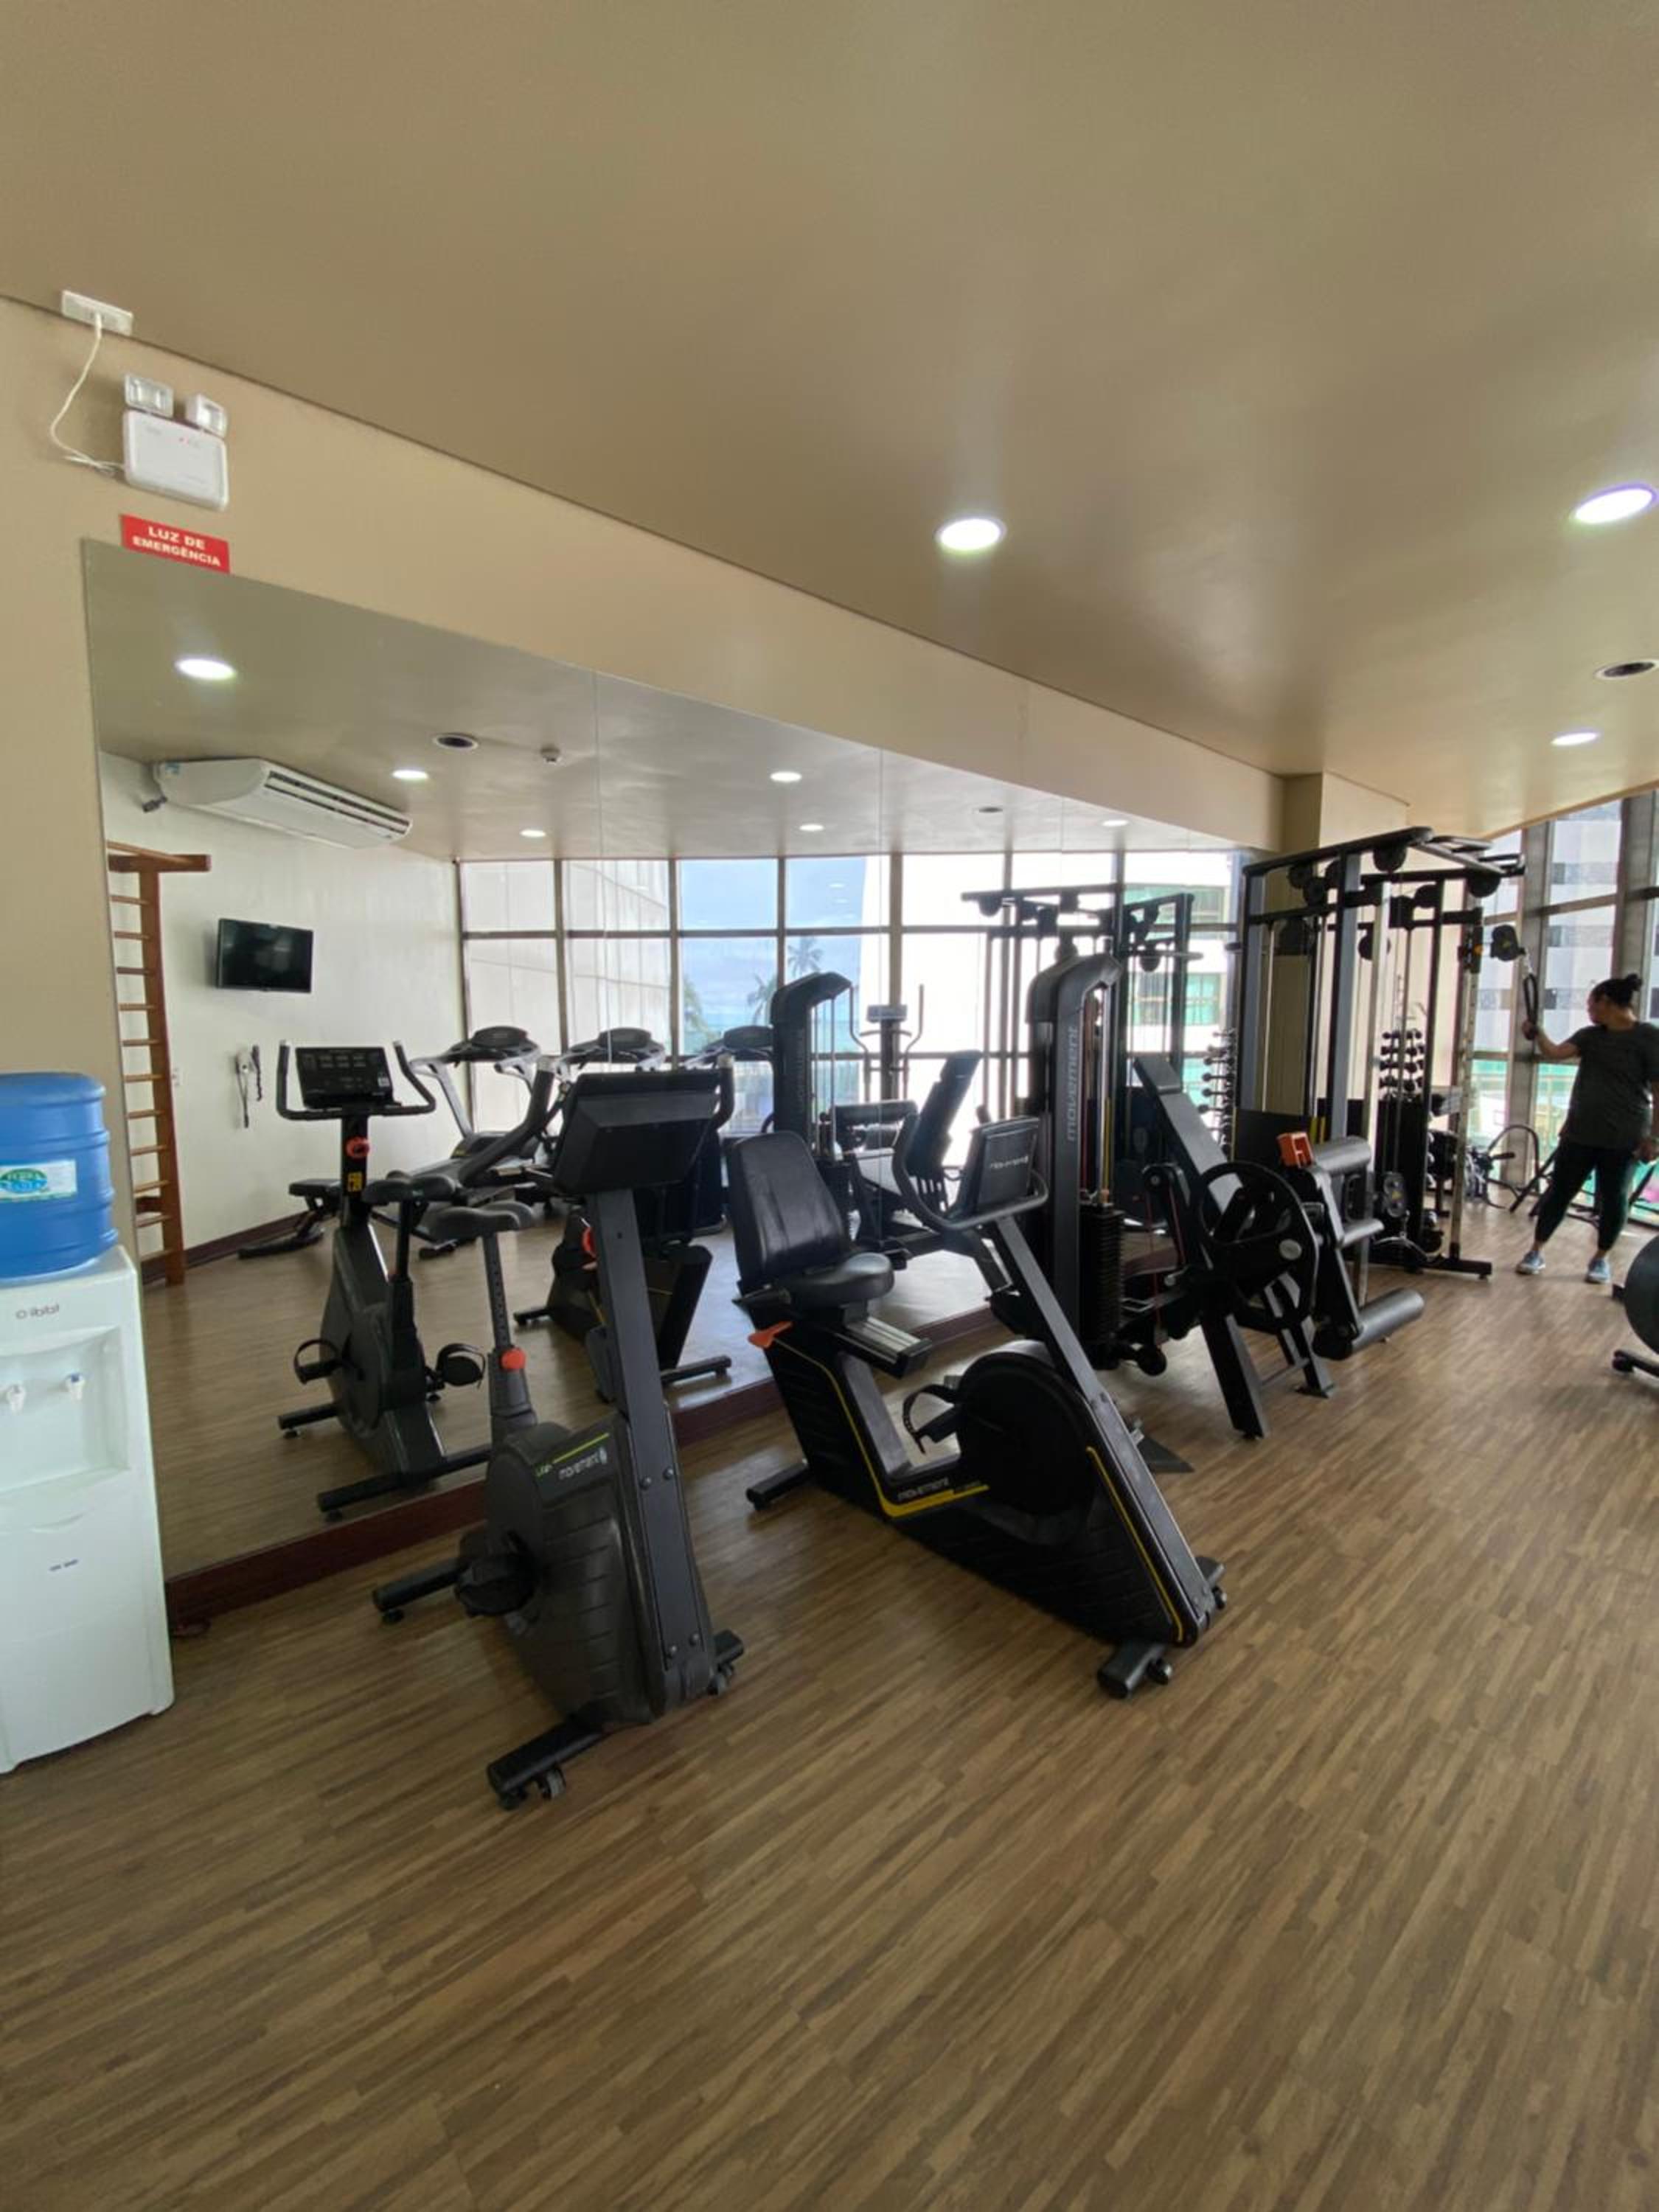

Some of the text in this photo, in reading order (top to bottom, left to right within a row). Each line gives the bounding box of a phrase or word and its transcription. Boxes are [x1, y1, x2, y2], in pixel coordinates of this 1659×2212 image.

[132, 535, 221, 567] EMERGÊNCIA
[148, 526, 206, 550] LUZ DE
[1067, 1026, 1078, 1142] movement
